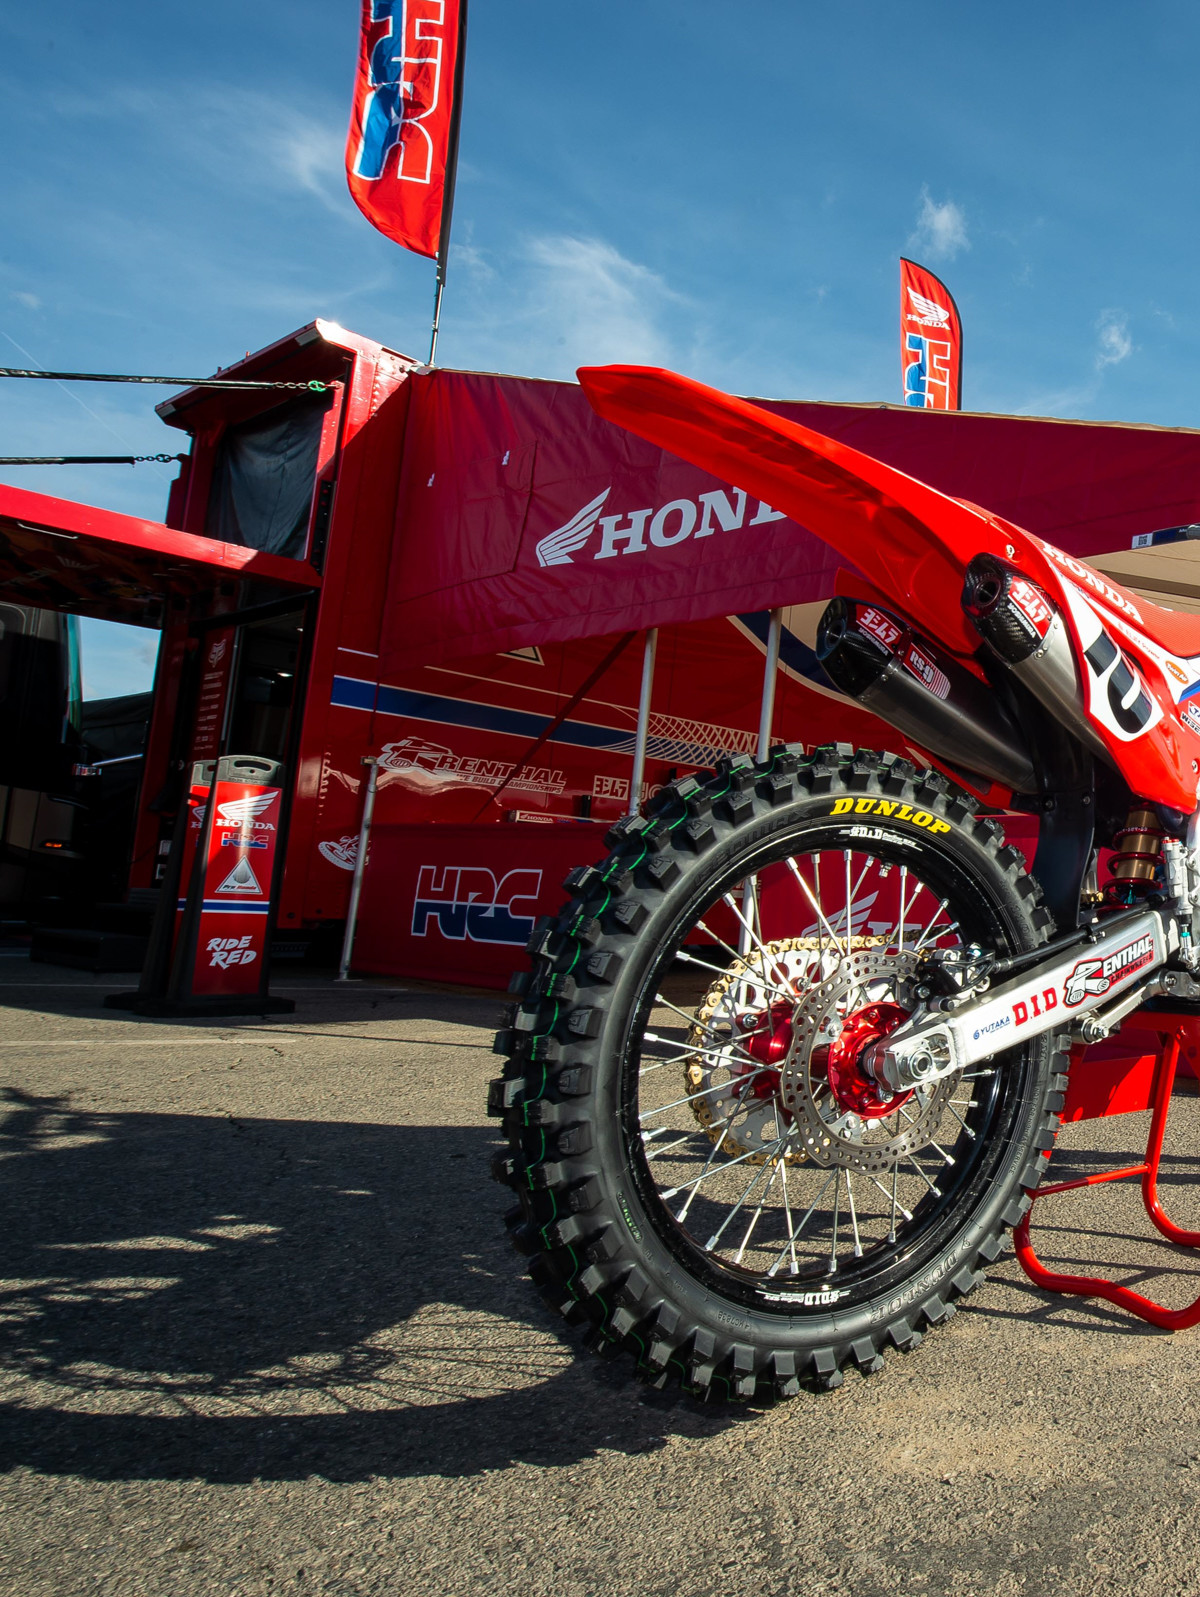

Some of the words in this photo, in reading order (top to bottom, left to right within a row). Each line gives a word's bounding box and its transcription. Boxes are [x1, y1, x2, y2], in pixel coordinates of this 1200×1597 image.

[906, 313, 951, 331] HONDA
[593, 486, 788, 560] HON
[1042, 542, 1144, 625] HONDA
[1011, 581, 1047, 623] ヨシムラ
[860, 608, 899, 644] ヨシムラ
[216, 818, 276, 831] HONDA
[829, 797, 951, 834] DUNLOP
[411, 866, 542, 946] HRC
[205, 936, 254, 953] RIDE
[209, 950, 257, 970] RED
[1012, 987, 1058, 1027] D.I.D
[980, 1015, 1010, 1036] YUTAKA
